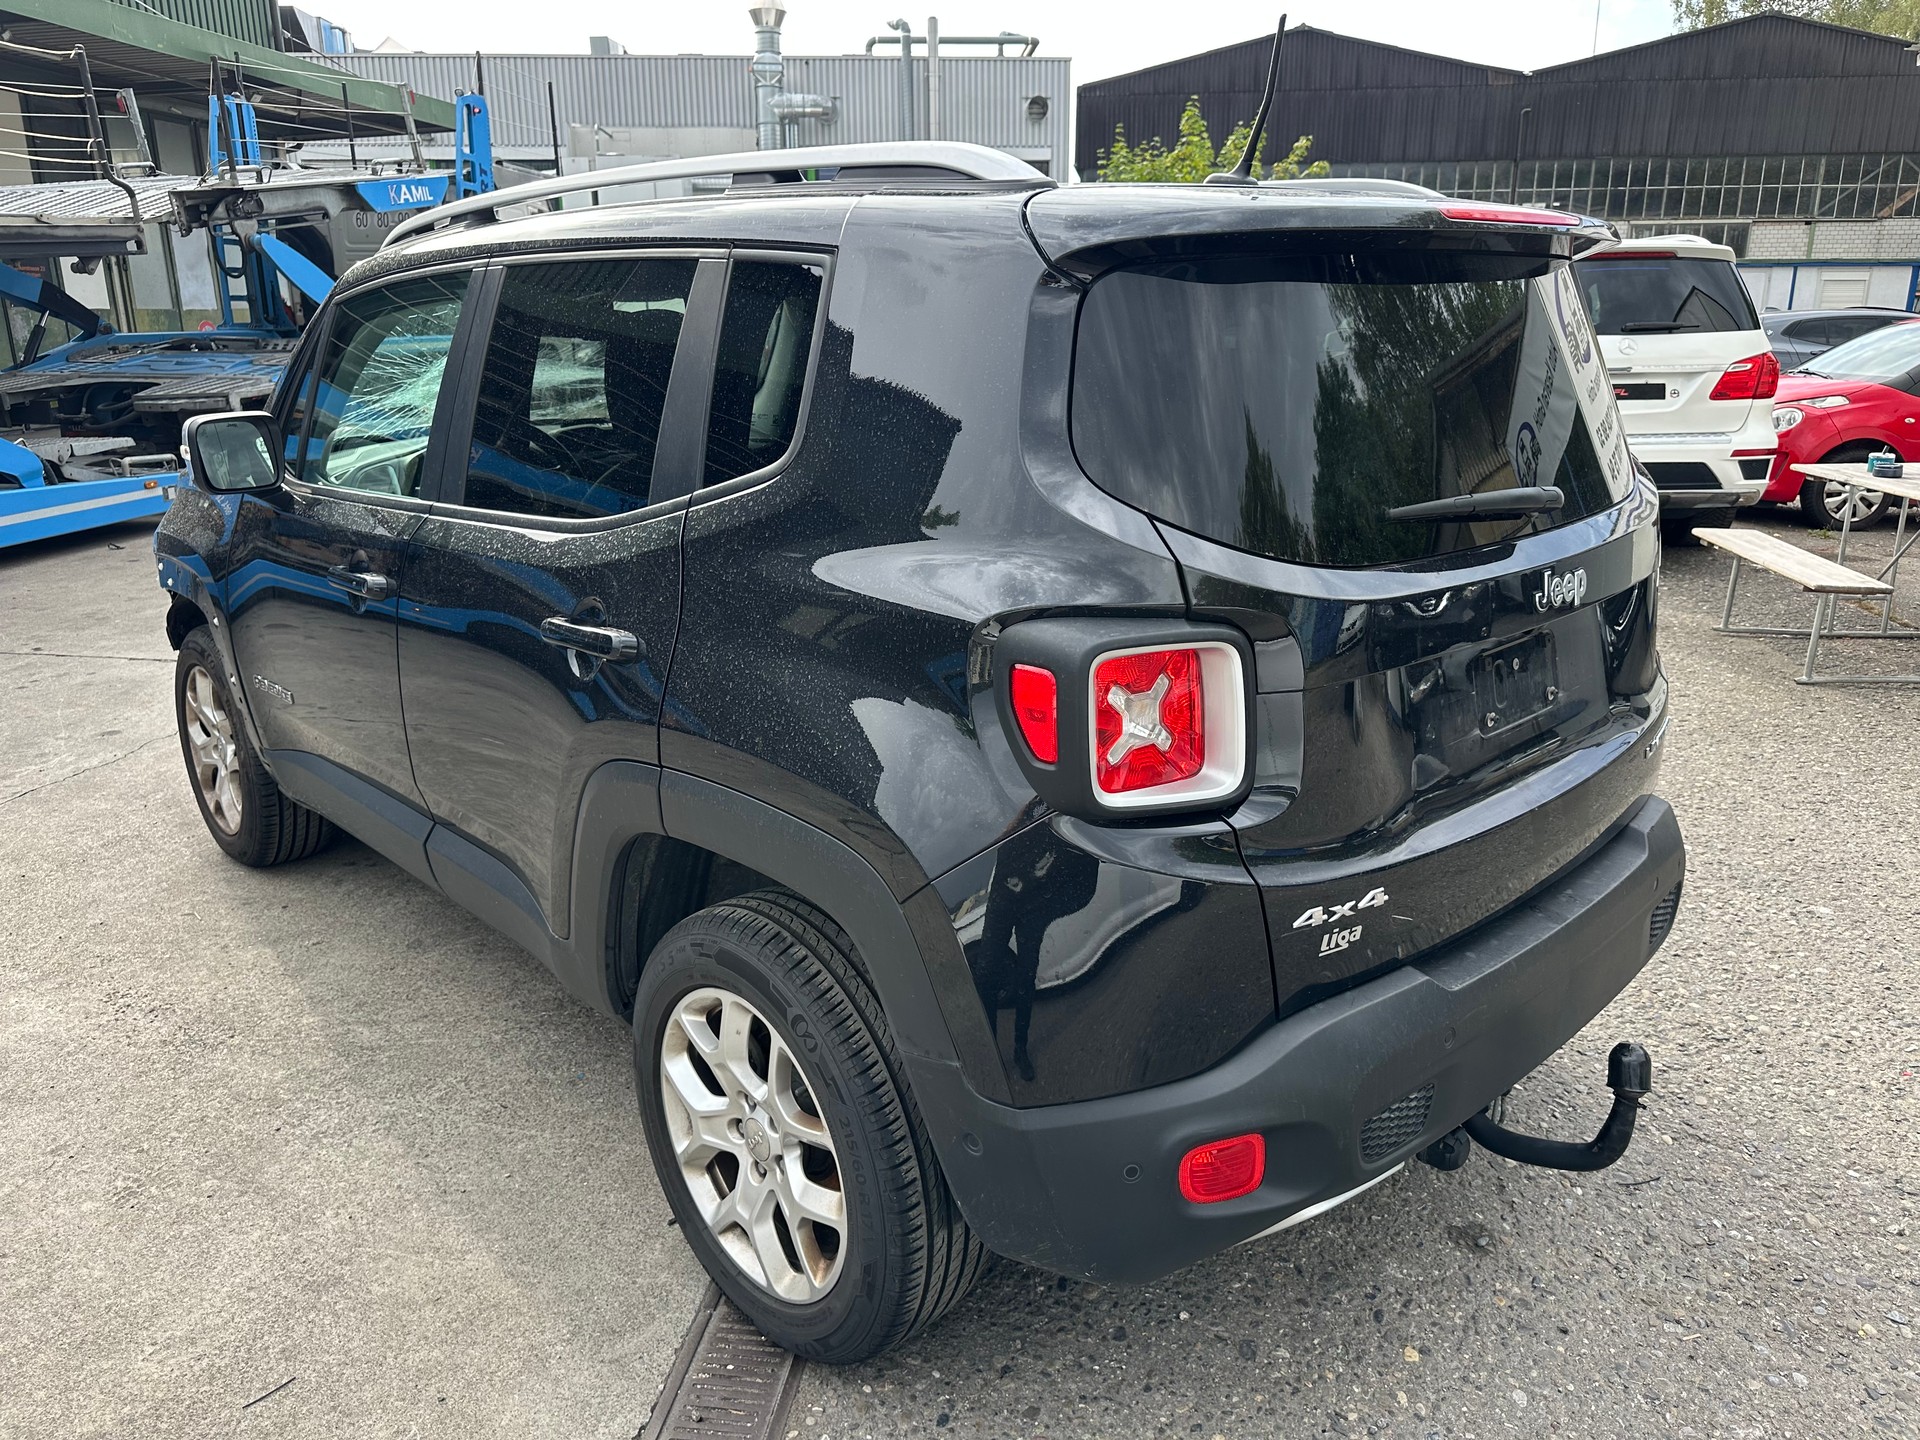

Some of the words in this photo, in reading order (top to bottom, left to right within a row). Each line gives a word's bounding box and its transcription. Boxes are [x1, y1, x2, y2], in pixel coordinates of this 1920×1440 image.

[387, 184, 433, 205] KAMIL
[355, 212, 368, 228] 60
[376, 212, 389, 228] 80
[1535, 568, 1587, 612] Jeep
[1292, 886, 1390, 929] 4x4
[1318, 924, 1363, 957] Liga
